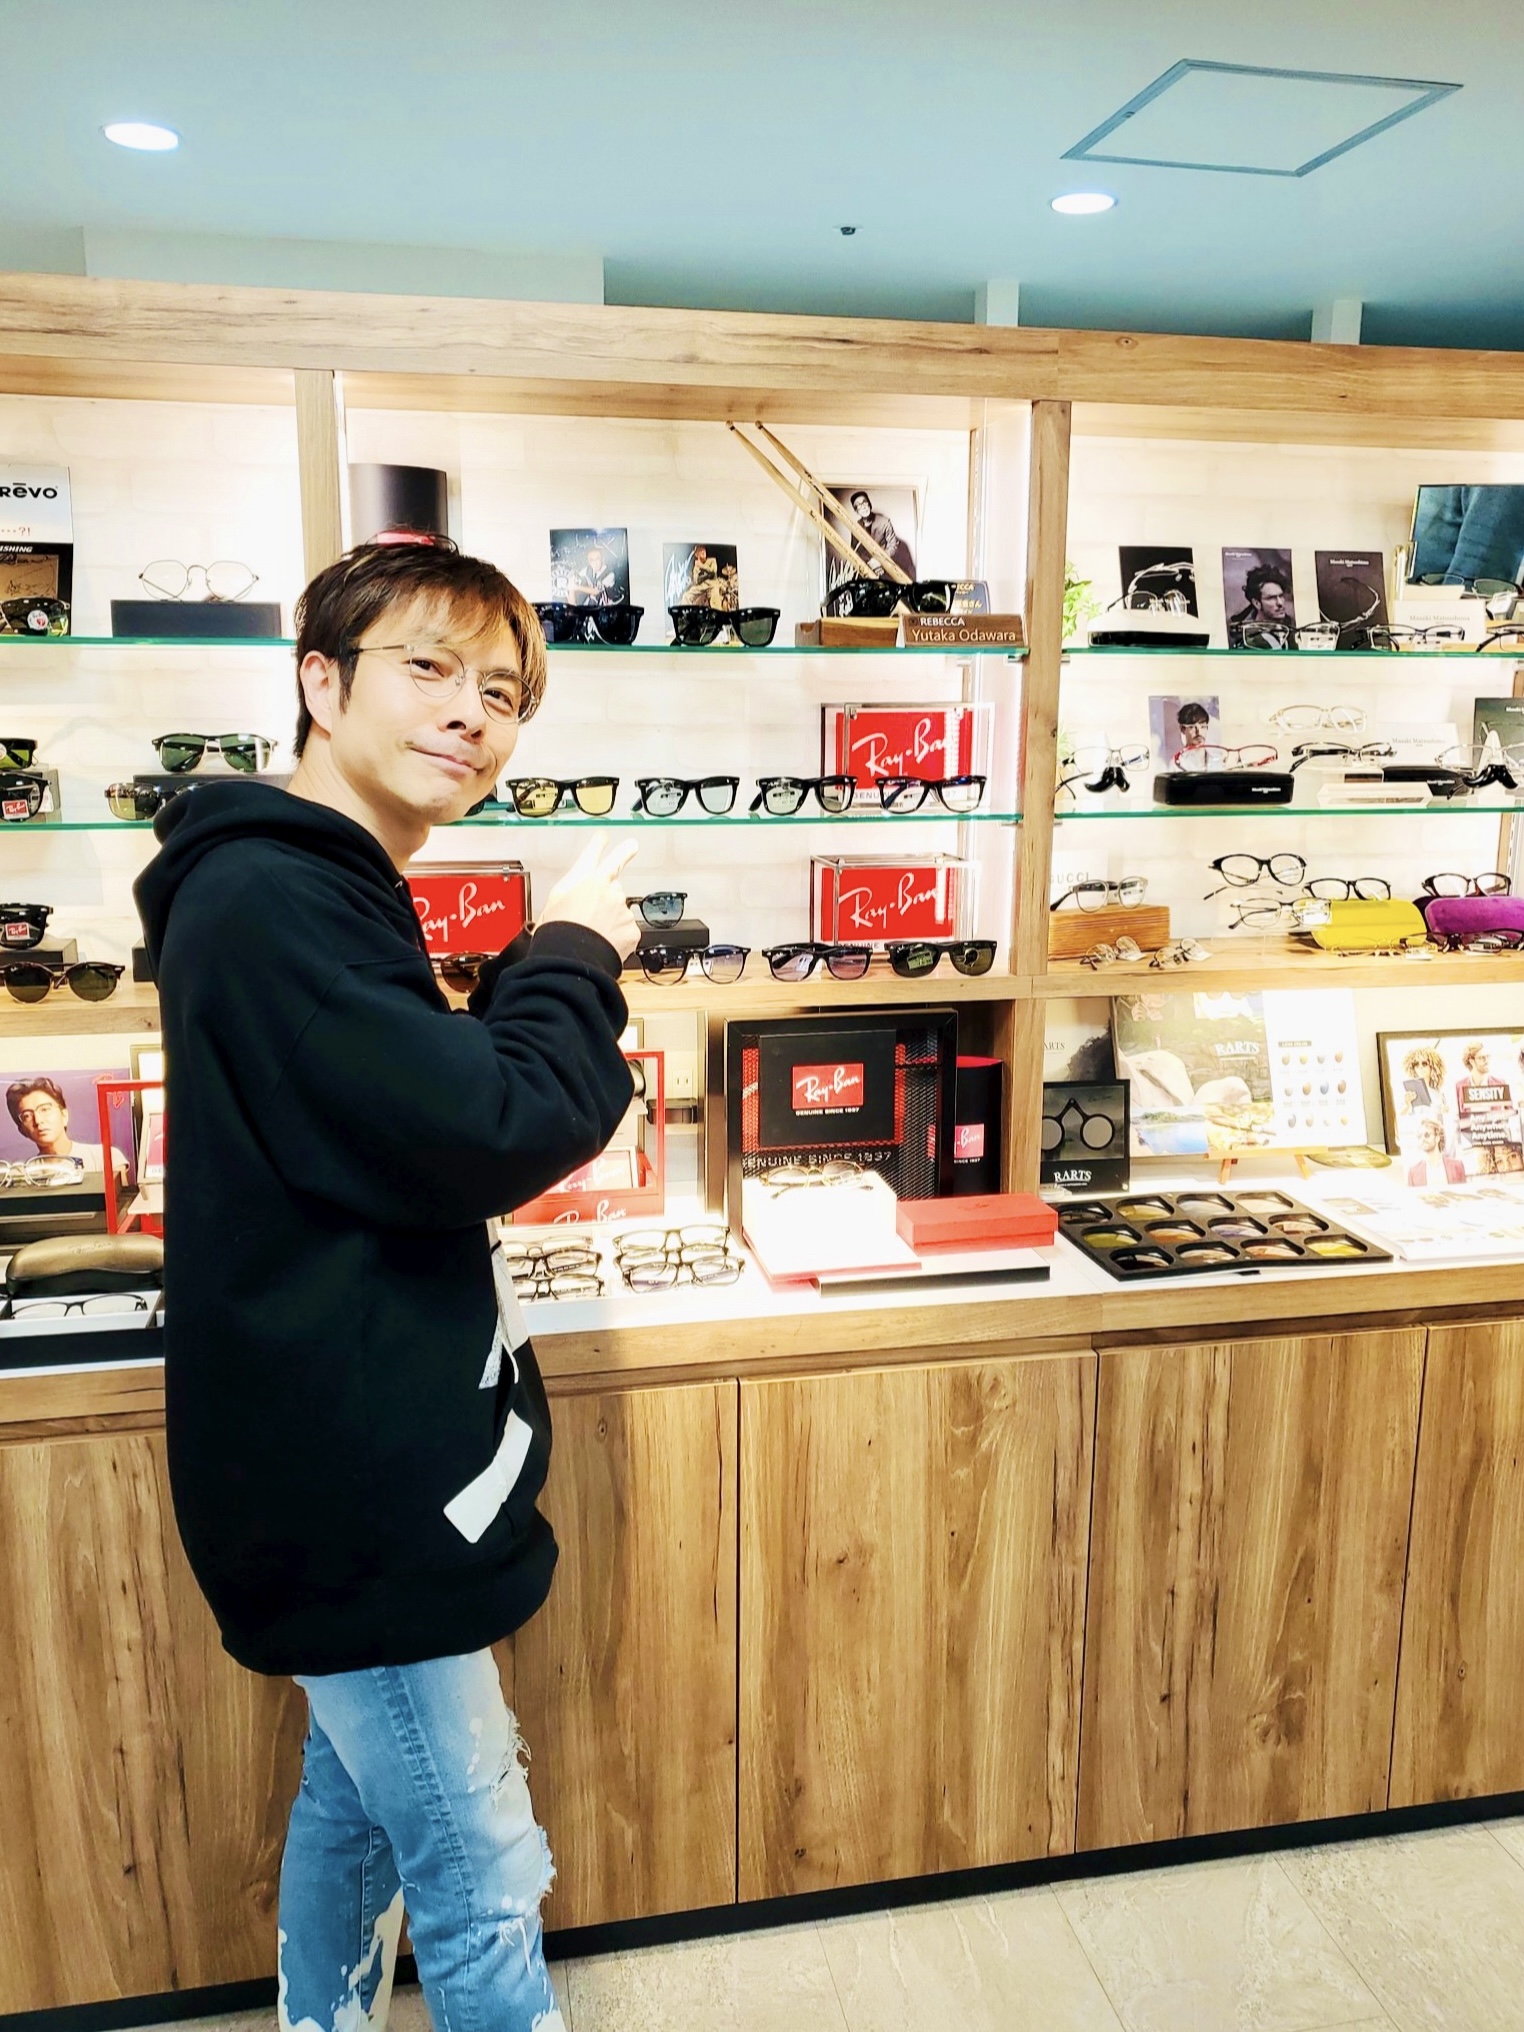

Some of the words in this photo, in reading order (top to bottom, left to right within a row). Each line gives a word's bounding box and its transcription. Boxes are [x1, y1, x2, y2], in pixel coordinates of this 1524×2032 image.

[920, 616, 965, 627] REBECCA
[912, 628, 955, 642] Yutaka
[959, 628, 1016, 642] Odawara
[1214, 1040, 1260, 1057] RARTS
[795, 1066, 861, 1104] Ray-Ban
[1468, 1087, 1505, 1101] SENSITY
[1053, 1169, 1092, 1182] RARTS
